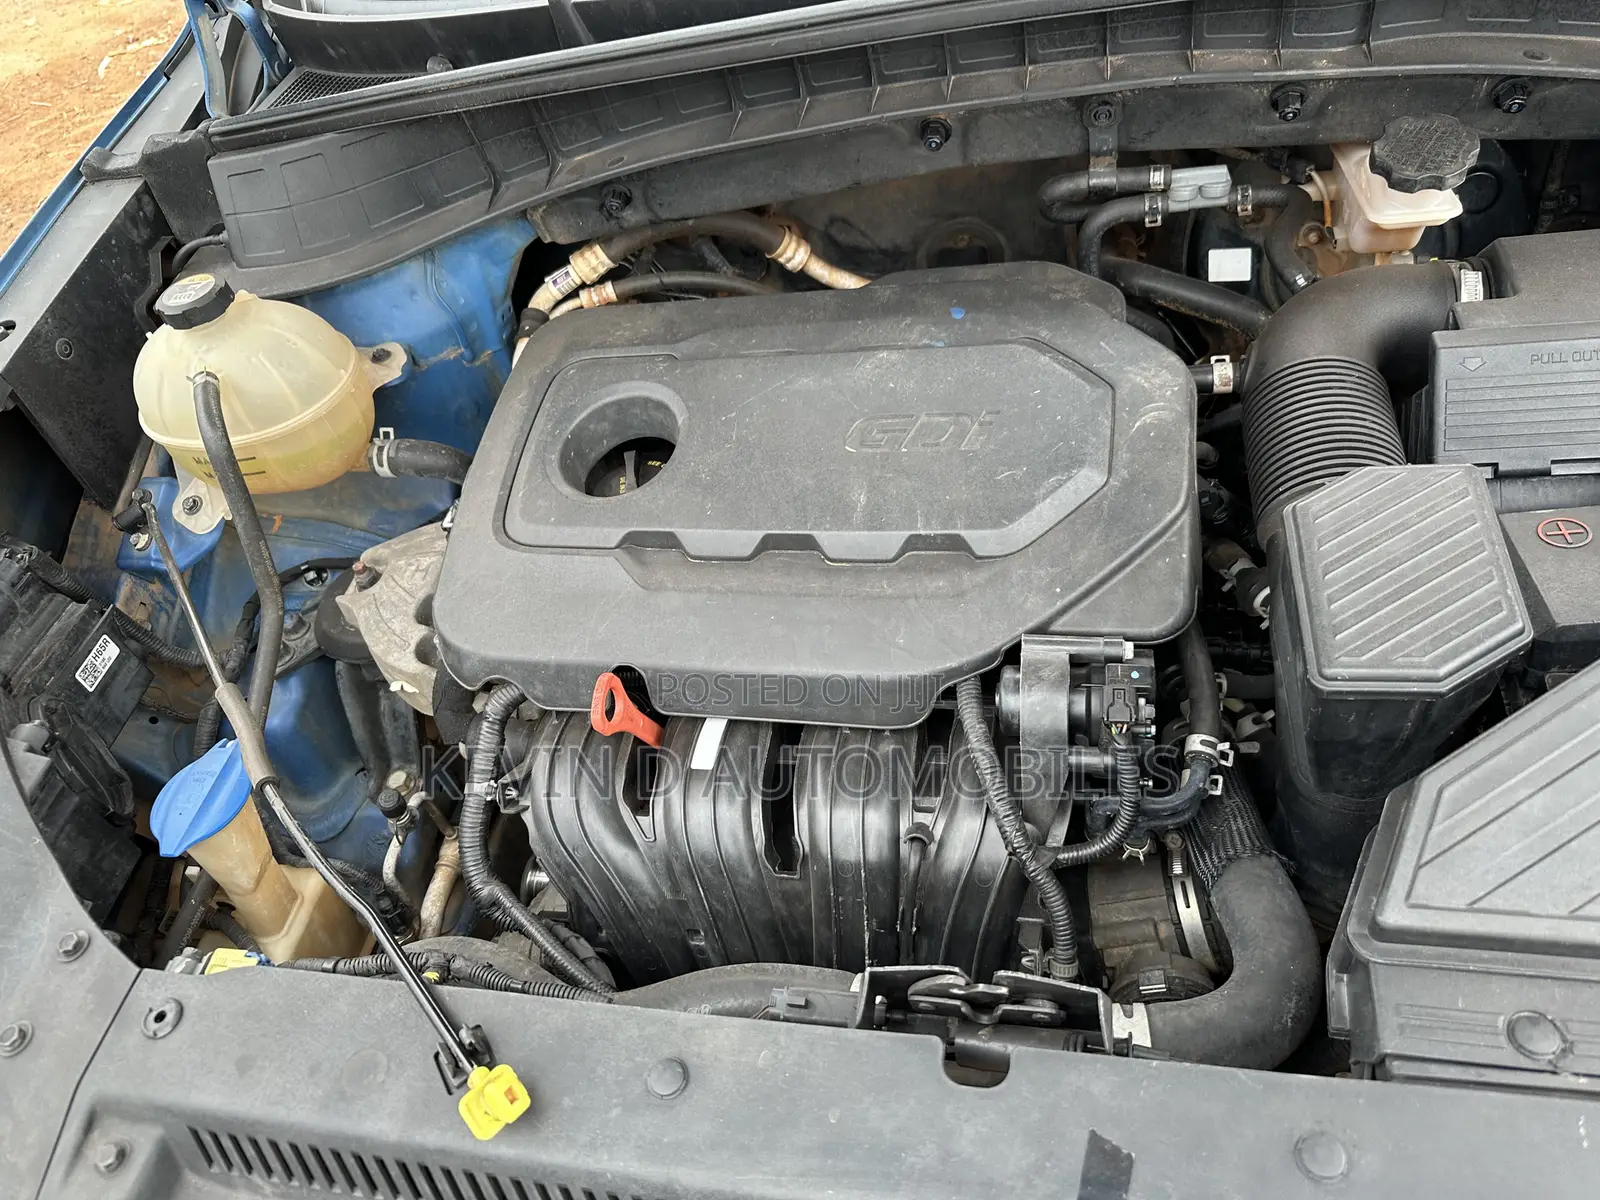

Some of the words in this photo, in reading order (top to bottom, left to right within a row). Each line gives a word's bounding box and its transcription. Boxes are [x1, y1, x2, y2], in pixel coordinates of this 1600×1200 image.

[1530, 352, 1568, 365] PULL
[845, 410, 1000, 452] GDi
[91, 637, 111, 662] H65R
